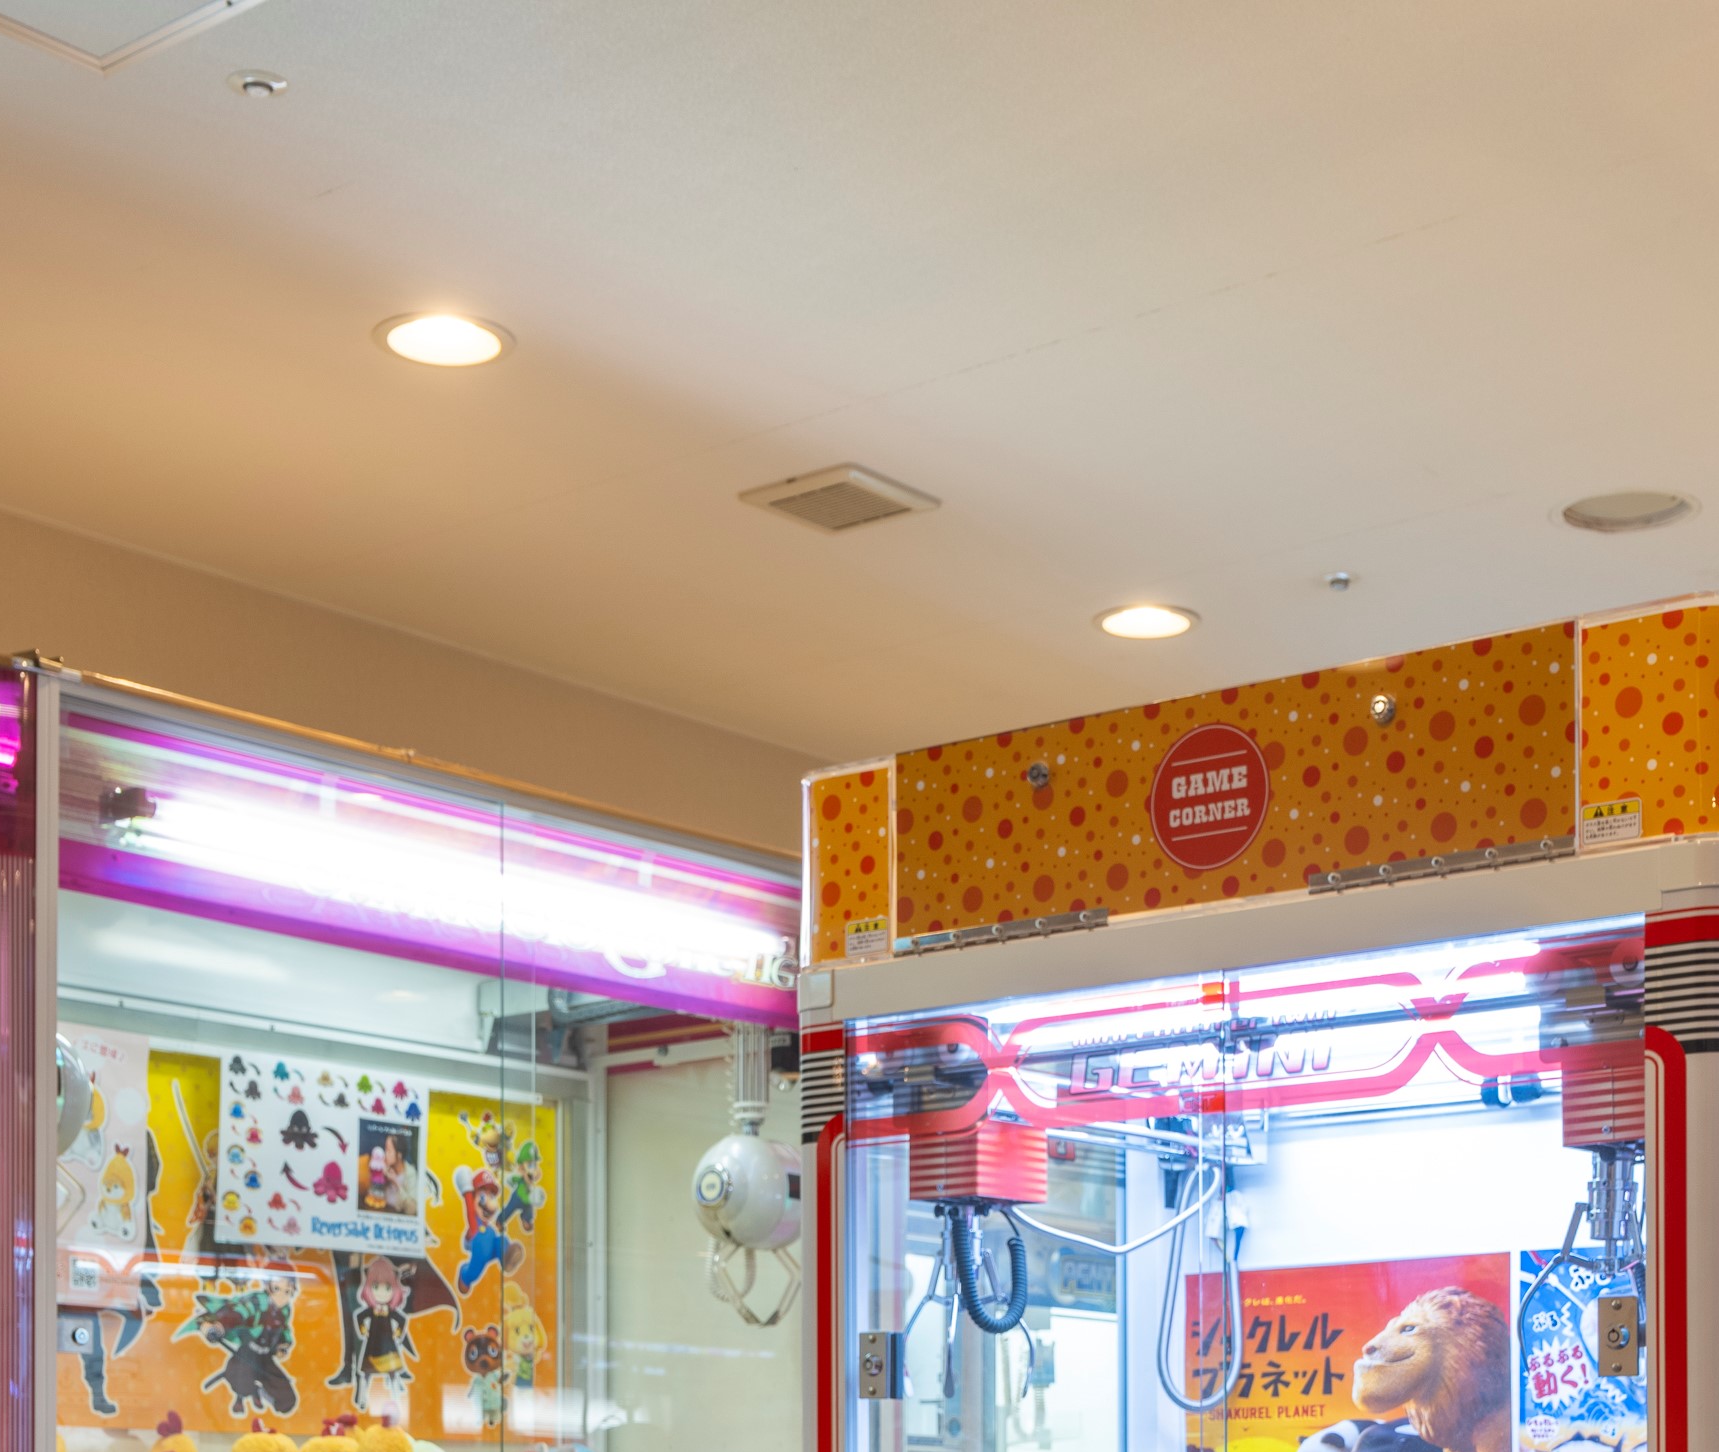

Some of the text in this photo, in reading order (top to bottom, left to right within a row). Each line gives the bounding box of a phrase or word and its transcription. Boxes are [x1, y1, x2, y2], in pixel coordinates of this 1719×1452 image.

[1171, 765, 1248, 800] GAME
[1168, 797, 1251, 828] CORNER
[1069, 1027, 1333, 1095] GEMINI
[1209, 1403, 1326, 1421] SHAKUREL PLANET
